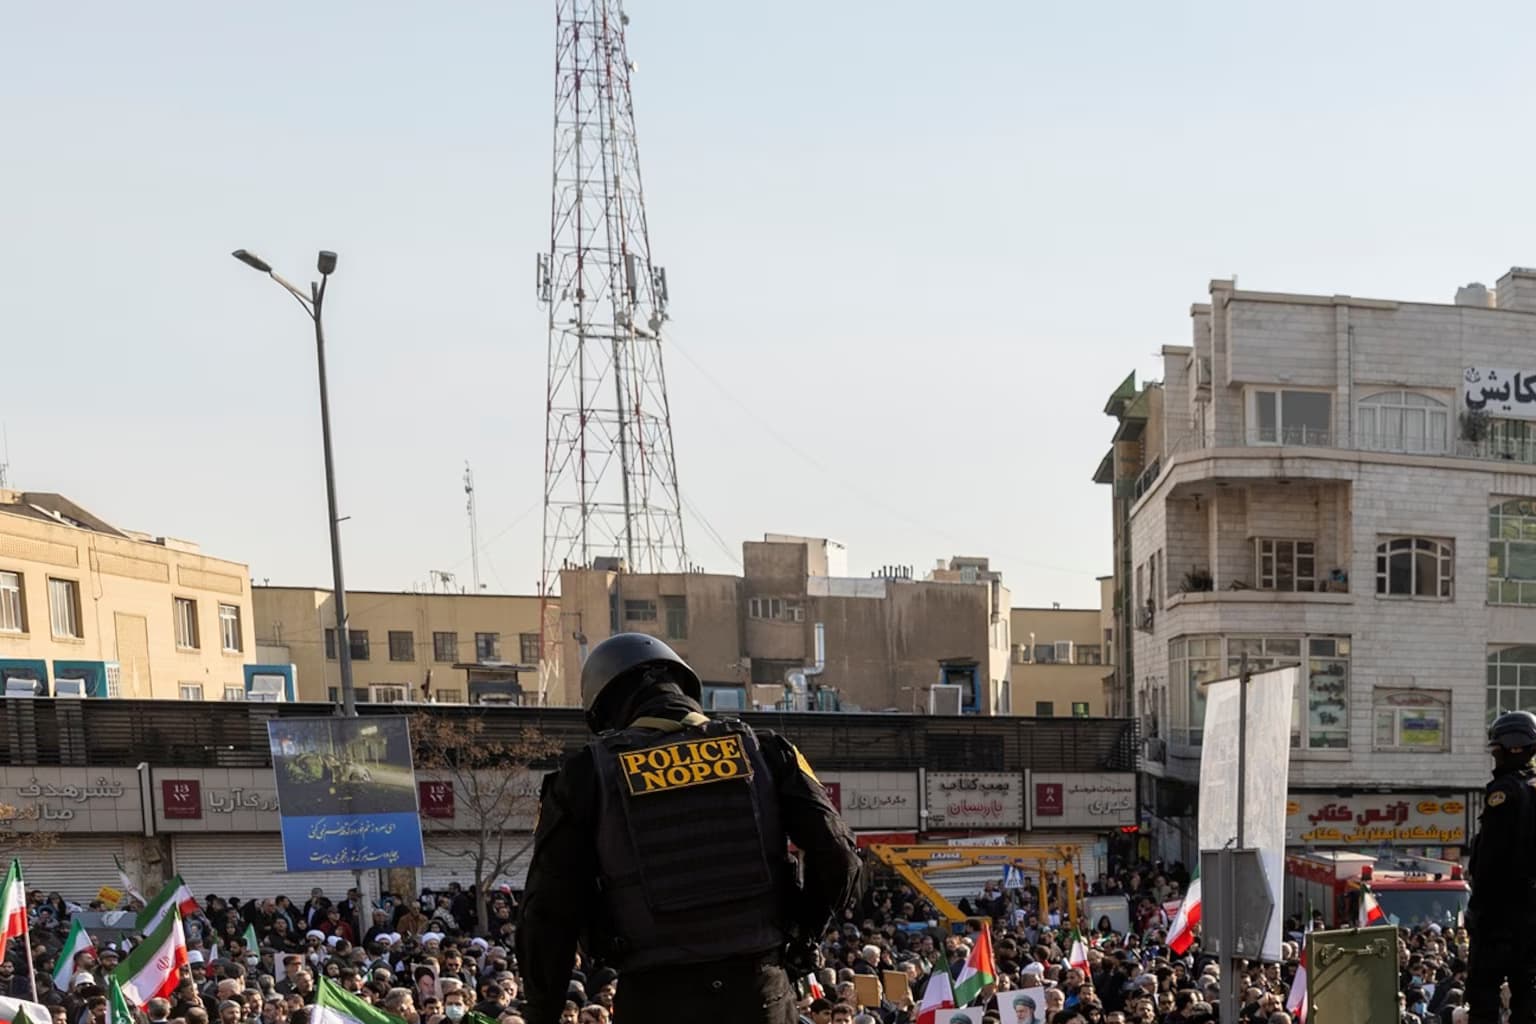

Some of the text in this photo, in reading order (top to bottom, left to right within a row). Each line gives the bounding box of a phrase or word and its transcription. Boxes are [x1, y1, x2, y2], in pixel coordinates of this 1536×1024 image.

[624, 739, 741, 775] POLICE
[642, 759, 738, 790] NOPO
[17, 776, 126, 803] نشر هدف
[941, 778, 979, 797] کتاب
[209, 788, 243, 813] آریا
[1308, 803, 1353, 826] کتاب
[1356, 801, 1411, 826] آژانس
[1301, 824, 1464, 842] فروشگاه اینترنتی کتاب
